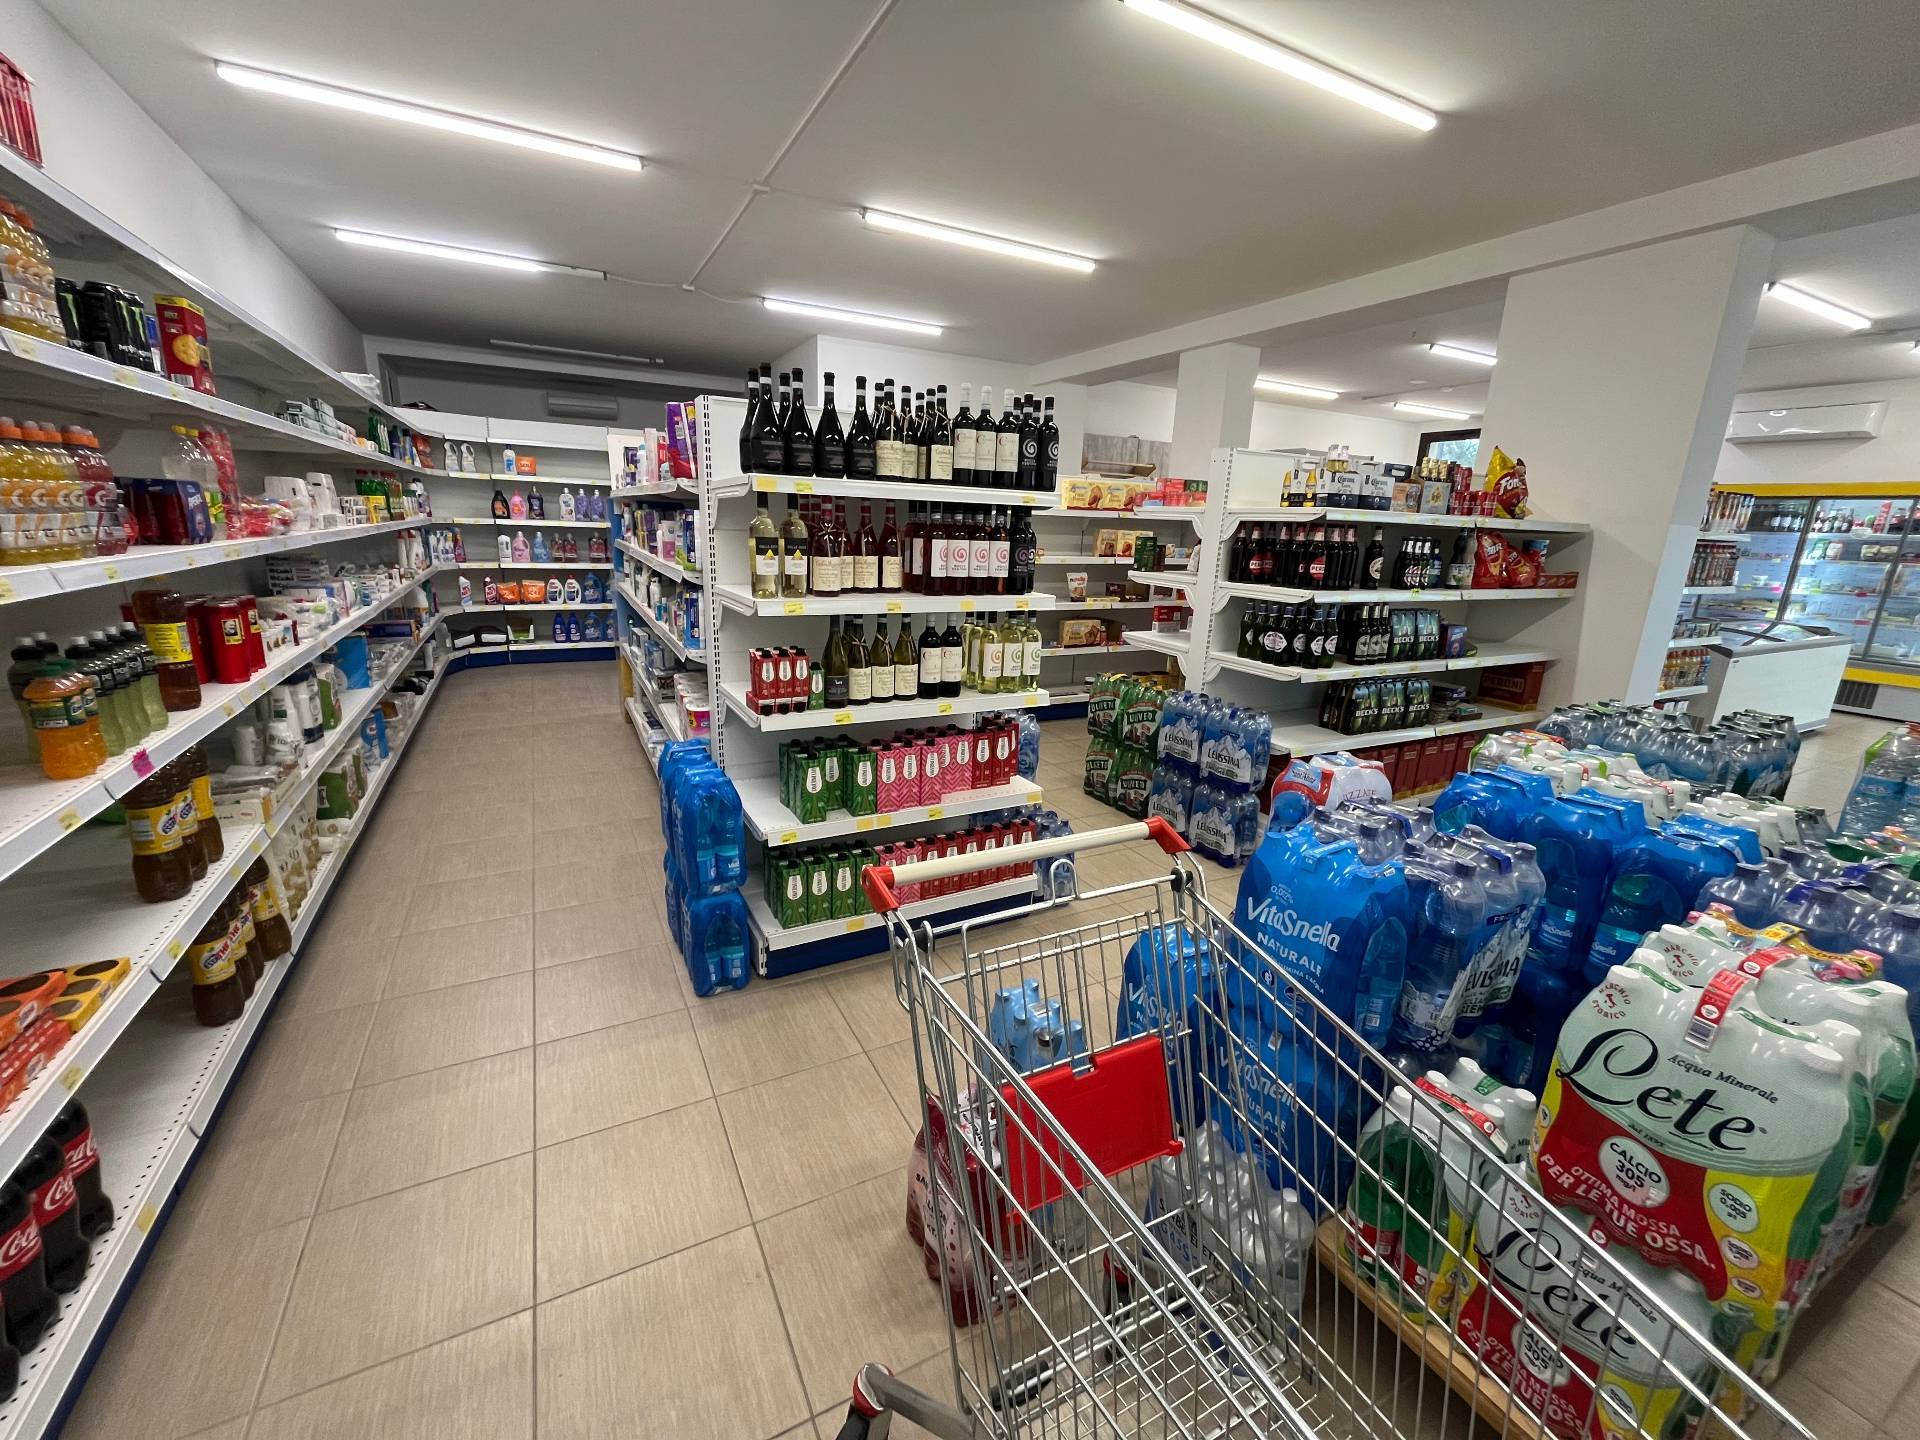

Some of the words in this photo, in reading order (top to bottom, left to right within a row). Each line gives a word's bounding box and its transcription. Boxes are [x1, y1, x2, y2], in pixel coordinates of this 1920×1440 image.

[1247, 896, 1341, 953] VitaSnella
[1257, 931, 1322, 977] NATURALE
[1555, 1027, 1756, 1151] Lete
[1667, 1052, 1713, 1077] Acqua
[1715, 1068, 1779, 1104] Minerale
[1609, 1141, 1662, 1185] CALCIO
[1615, 1158, 1645, 1188] 305
[1540, 1153, 1572, 1189] PER
[1575, 1180, 1602, 1200] LE
[1603, 1197, 1638, 1239] TUE
[1644, 1230, 1717, 1270] OSSA.
[1571, 1165, 1619, 1207] OTTIMA
[1622, 1203, 1682, 1238] MOSSA
[1720, 1187, 1752, 1213] SODIO
[1473, 1227, 1637, 1361] Lete
